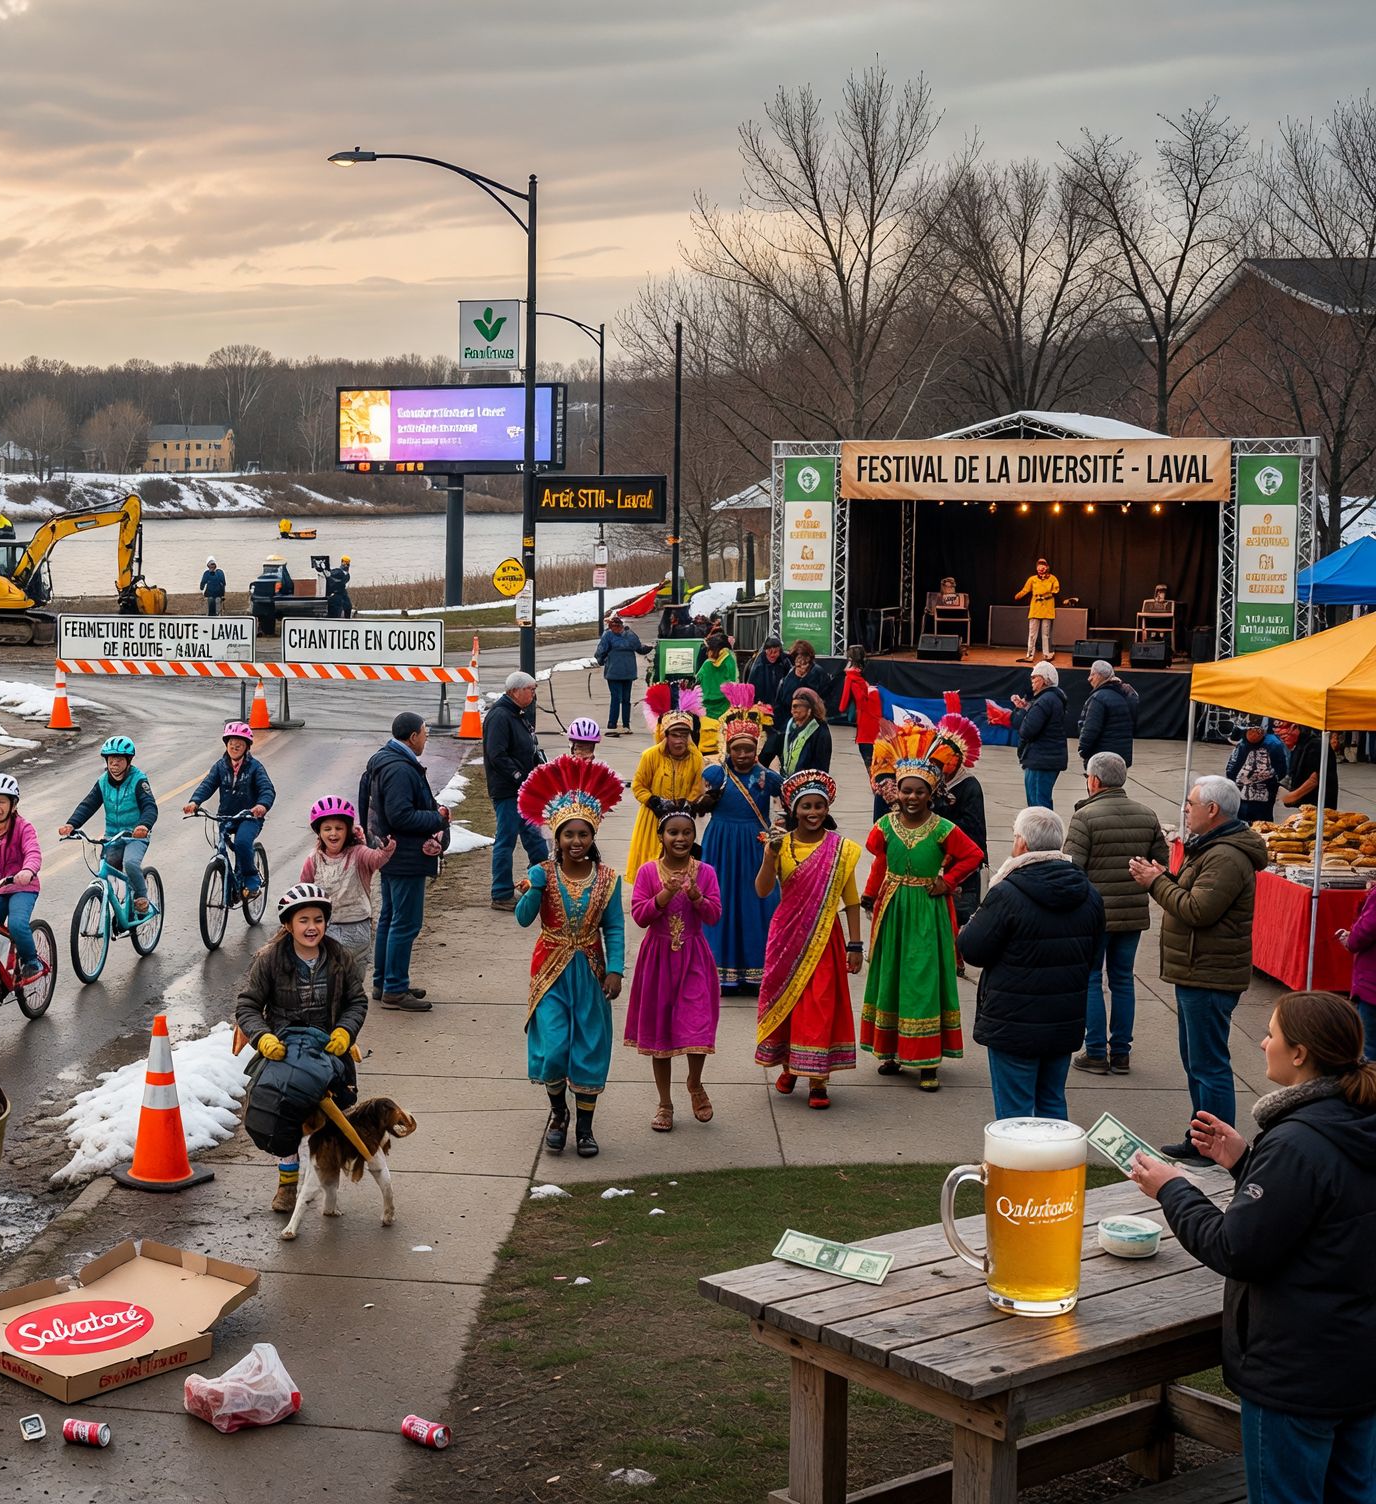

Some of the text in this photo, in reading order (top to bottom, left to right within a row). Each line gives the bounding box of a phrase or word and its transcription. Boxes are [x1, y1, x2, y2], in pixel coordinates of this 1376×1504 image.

[856, 455, 948, 483] FESTIVAL
[954, 455, 980, 483] DE
[986, 455, 1011, 484] LA
[1018, 447, 1124, 484] DIVERSITÉ
[1147, 454, 1214, 483] LAVAL
[64, 621, 135, 639] FERMETURE
[139, 622, 156, 639] DE
[159, 622, 199, 640] ROUTE
[211, 623, 248, 641] LAVAL
[288, 628, 436, 651] CHANTIER EN COURS
[18, 1304, 144, 1351] Salvatoré
